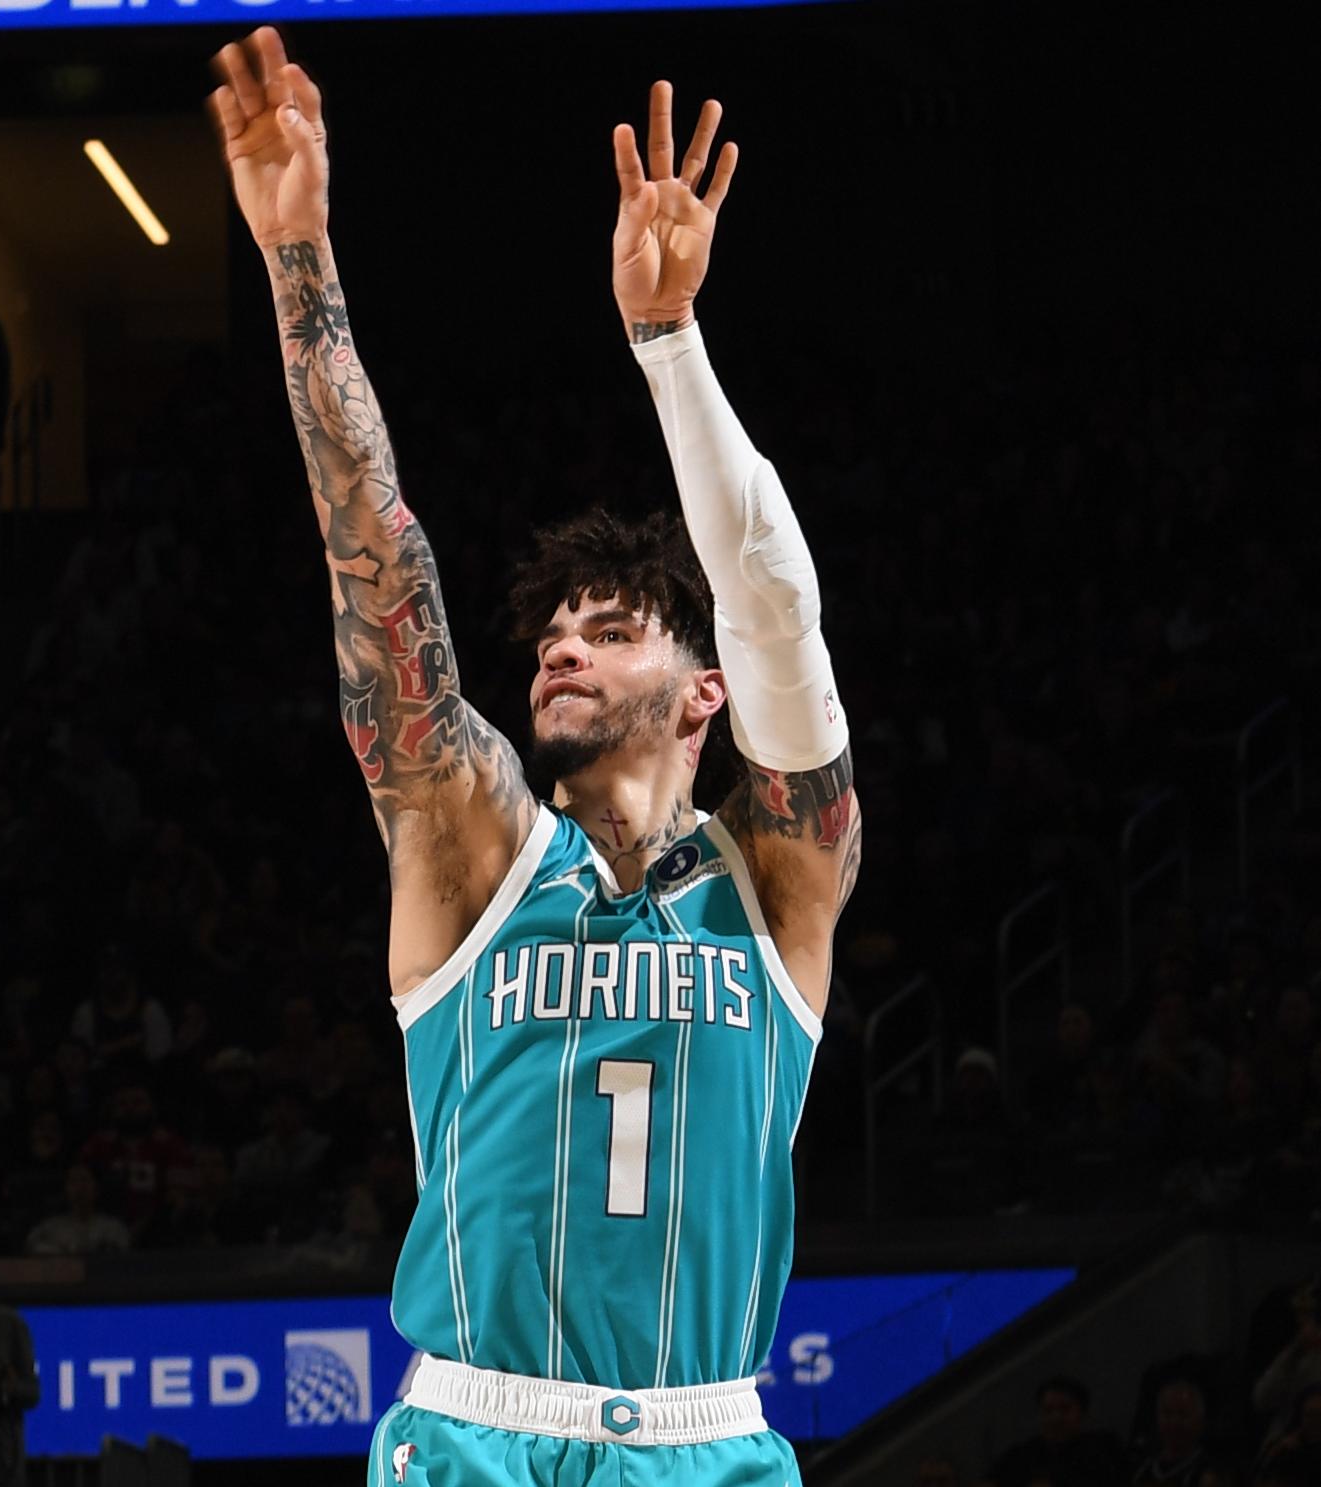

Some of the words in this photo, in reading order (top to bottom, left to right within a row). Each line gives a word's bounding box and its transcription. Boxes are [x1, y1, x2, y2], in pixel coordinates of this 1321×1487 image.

[484, 940, 756, 1031] HORNETS
[595, 1058, 656, 1218] 1
[34, 1354, 261, 1411] ITED
